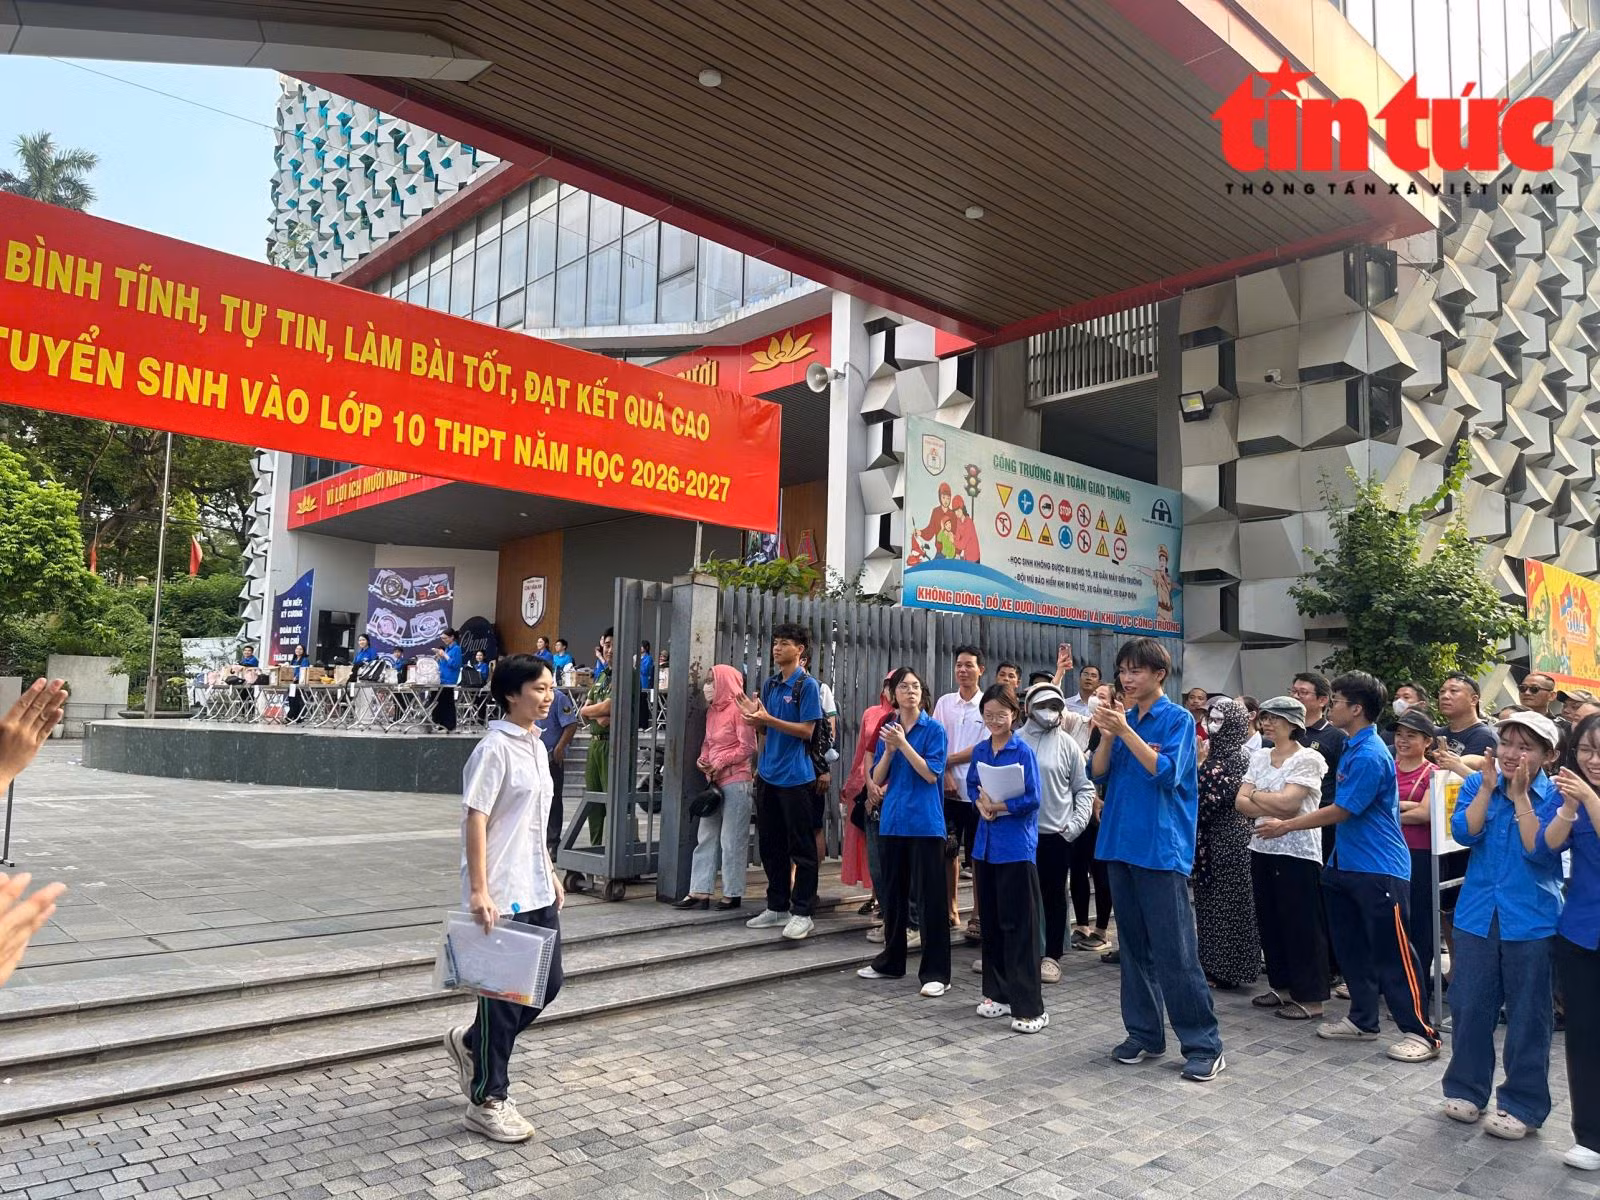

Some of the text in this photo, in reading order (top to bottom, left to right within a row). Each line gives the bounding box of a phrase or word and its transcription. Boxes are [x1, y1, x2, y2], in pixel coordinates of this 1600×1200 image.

[6, 235, 710, 441] BÌNH TĨNH, TỰ TIN, LÀM BÀI TỐT, ĐẠT KẾT QUẢ CAO
[137, 356, 228, 410] SINH
[240, 374, 310, 425] VÀO
[319, 392, 383, 437] LỚP
[392, 410, 426, 447] 10
[434, 417, 507, 461] THPT
[513, 431, 569, 474] NĂM
[575, 447, 625, 489] HỌC
[630, 458, 731, 502] 2026-2027
[335, 483, 347, 506] LỢI
[348, 477, 361, 499] ÍCH
[363, 468, 385, 494] MƯỜI
[993, 454, 1131, 502] CỔNG TRƯỜNG AN TOÀN GIAO THÔNG
[1060, 506, 1072, 515] STOP
[1022, 558, 1033, 567] SINH
[1034, 560, 1050, 570] KHÔNG
[917, 586, 952, 603] KHÔNG
[985, 593, 999, 608] ĐỖ
[1001, 598, 1012, 611] XE
[1015, 599, 1035, 613] DƯỚI
[1037, 602, 1058, 616] LÒNG
[1060, 605, 1087, 620] ĐƯỜNG
[1089, 610, 1100, 621] VÀ
[1101, 612, 1116, 624] KHU
[1118, 614, 1133, 628] VỰC
[1134, 615, 1153, 629] CỔNG
[1154, 618, 1180, 632] TRƯỜNG
